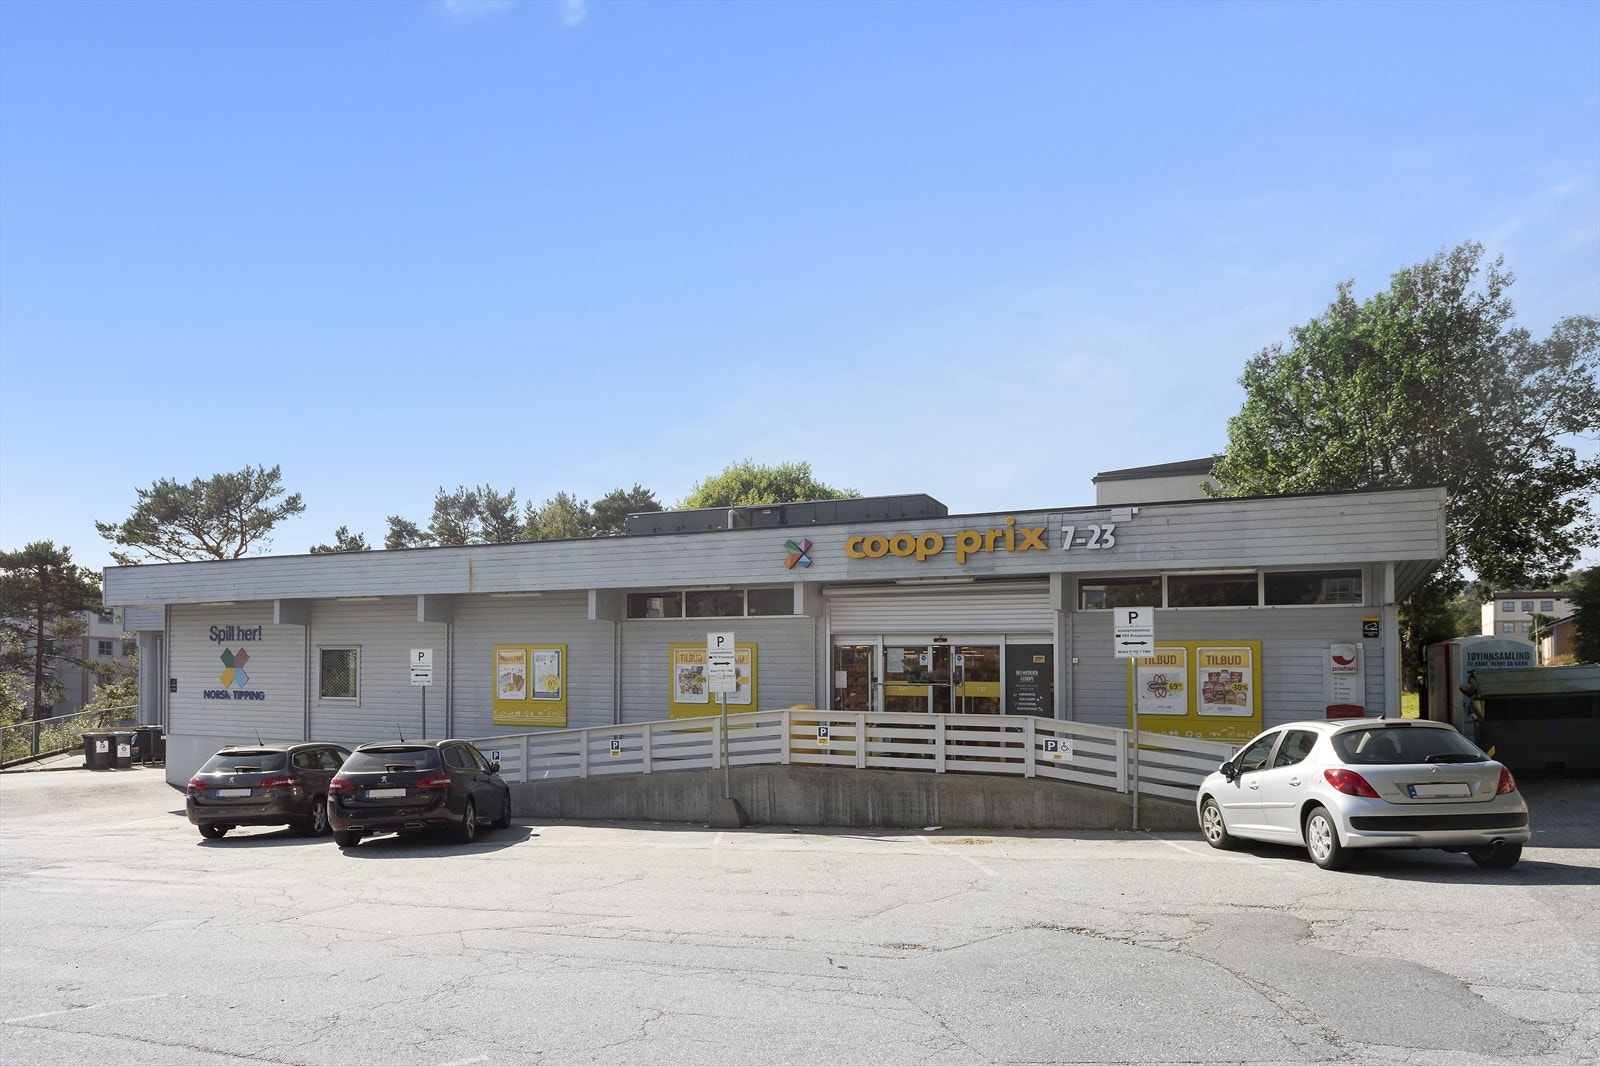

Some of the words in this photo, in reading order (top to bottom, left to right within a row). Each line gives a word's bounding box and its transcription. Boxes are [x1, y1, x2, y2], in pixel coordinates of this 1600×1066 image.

[844, 534, 944, 561] coop
[956, 516, 1049, 564] prix
[1060, 524, 1117, 550] 7-23
[1128, 612, 1138, 624] P
[210, 626, 234, 644] Spill
[237, 625, 262, 641] her!
[717, 636, 724, 647] P
[418, 652, 424, 661] P
[680, 654, 702, 662] TILBUD
[1144, 656, 1176, 664] TILBUD
[1206, 655, 1242, 665] TILBUD
[1467, 652, 1530, 660] TØYINNSAMLING
[233, 690, 265, 700] TIPPING
[820, 728, 826, 736] P
[1048, 741, 1056, 750] P
